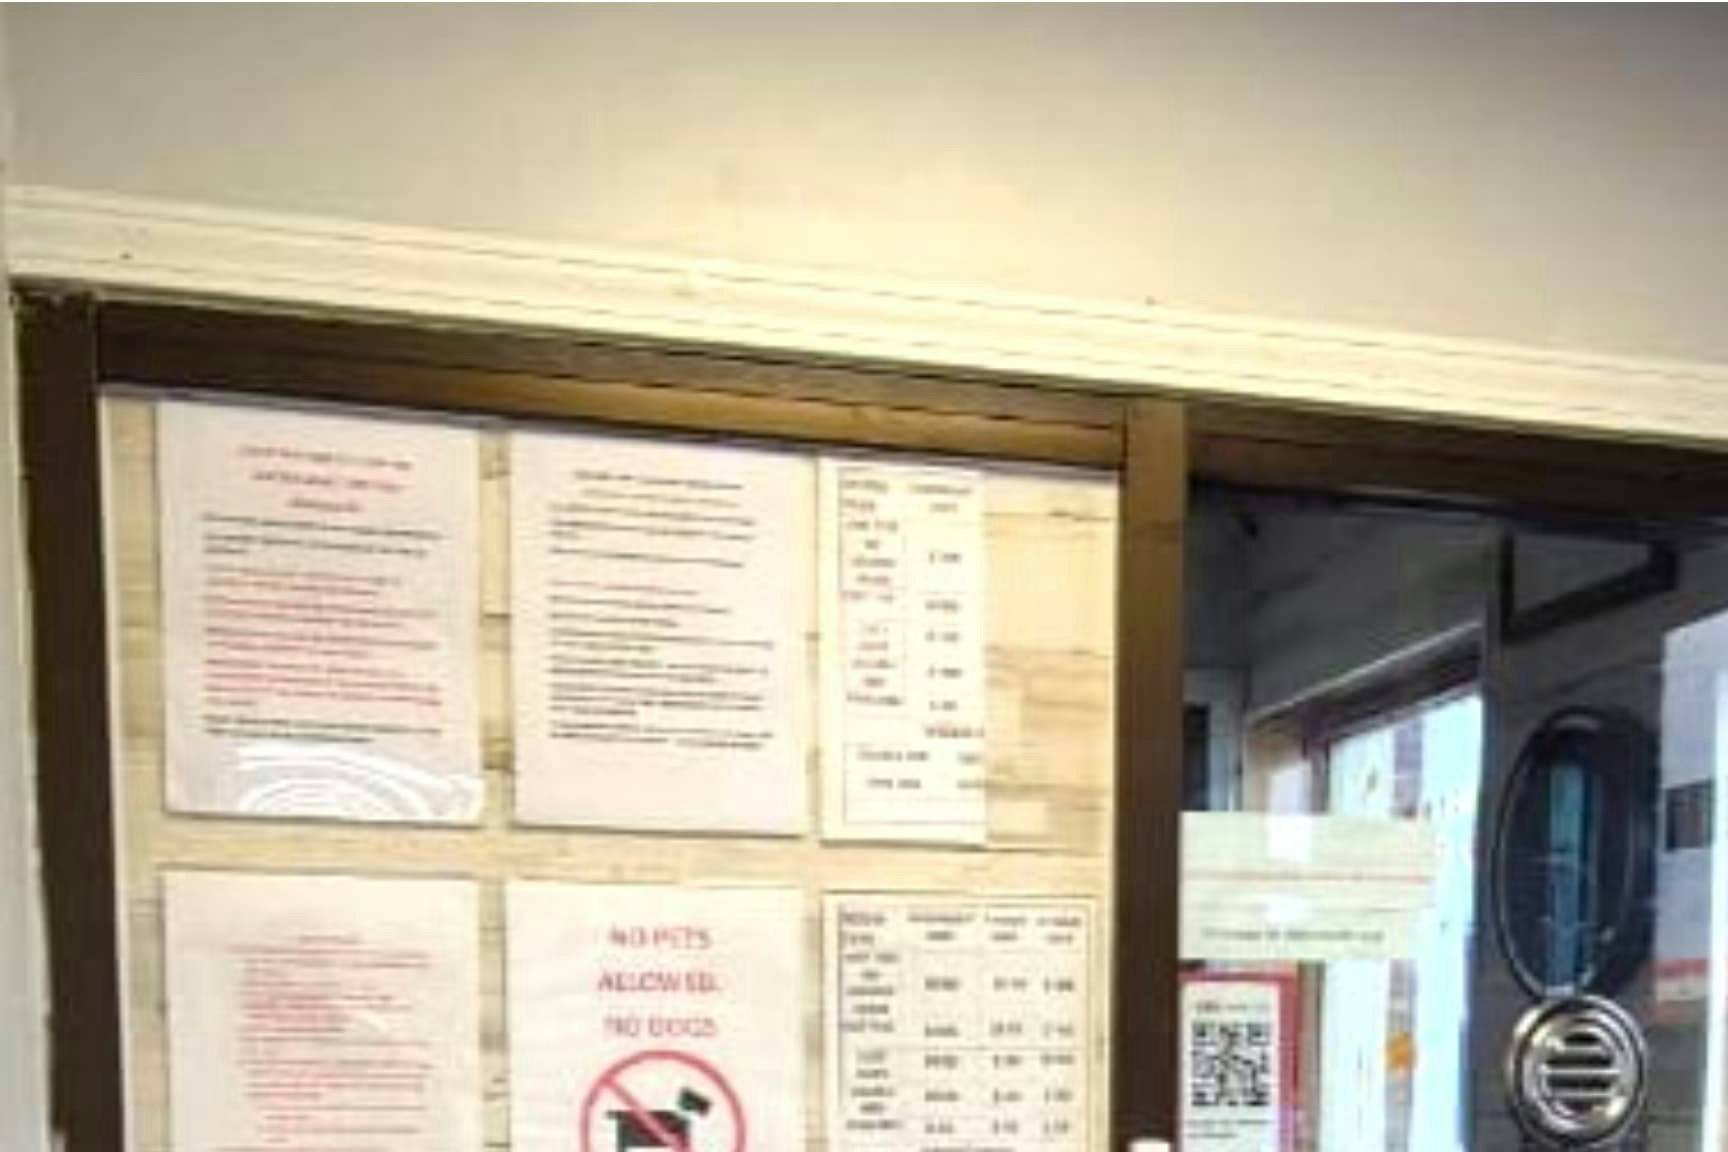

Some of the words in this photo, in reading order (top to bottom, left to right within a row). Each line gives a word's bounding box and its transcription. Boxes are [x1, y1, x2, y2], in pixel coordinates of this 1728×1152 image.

[607, 923, 647, 949] NO
[653, 924, 713, 950] PETS
[603, 1014, 641, 1037] NO
